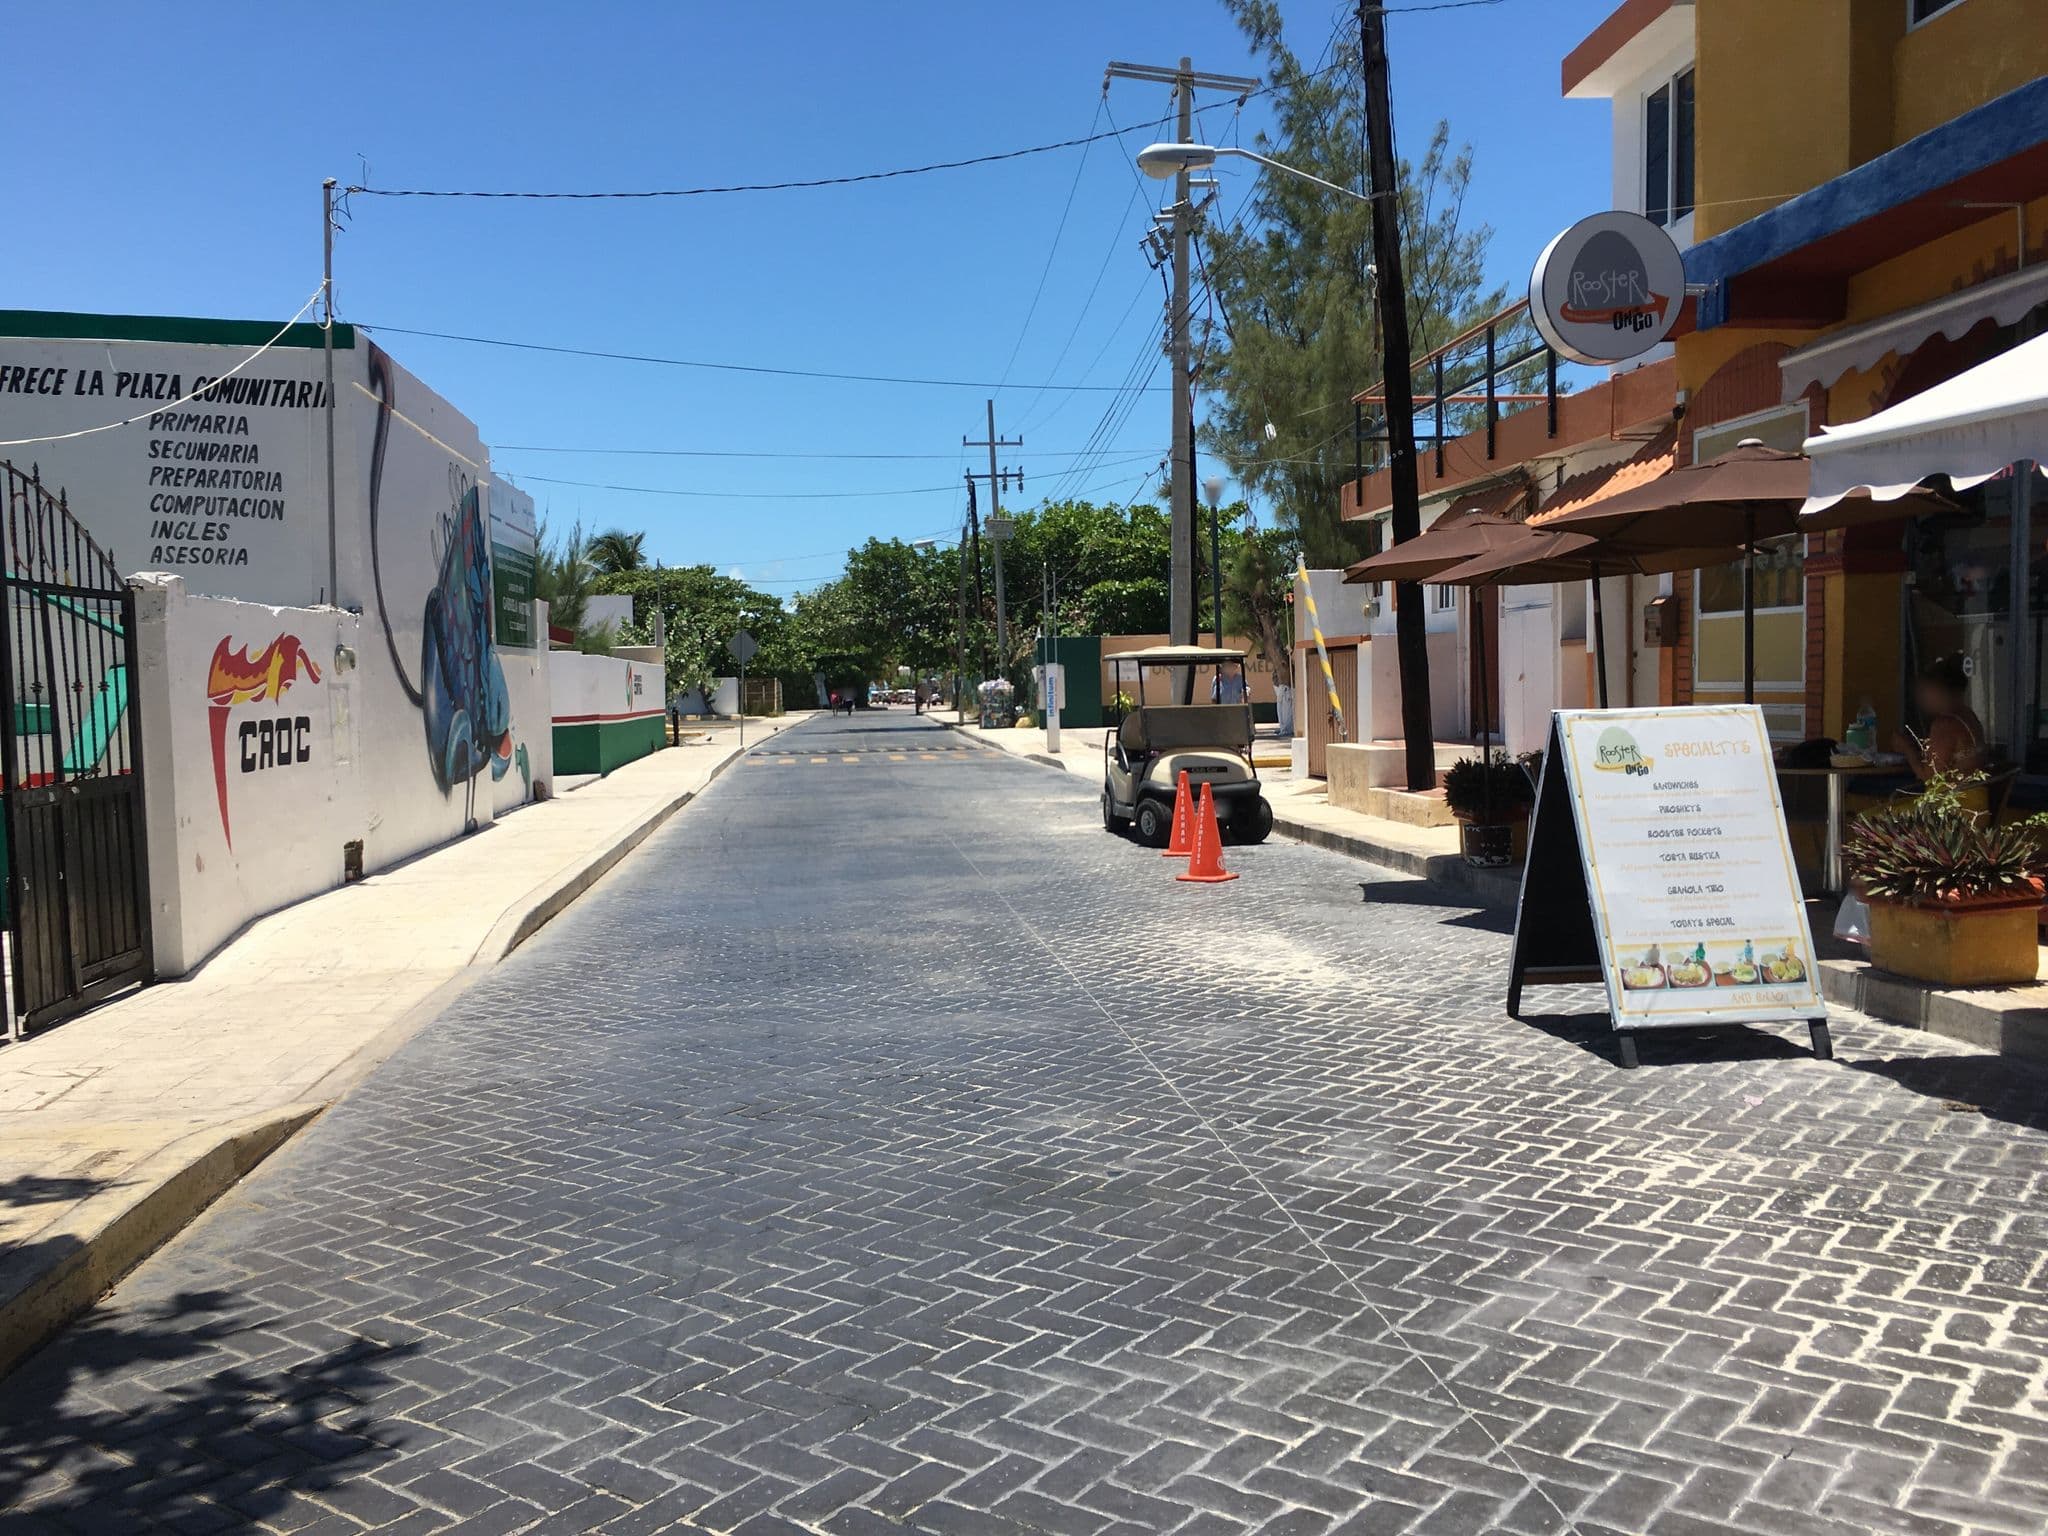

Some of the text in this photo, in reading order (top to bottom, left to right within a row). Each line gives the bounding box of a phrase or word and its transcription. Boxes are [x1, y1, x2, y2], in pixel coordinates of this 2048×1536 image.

[74, 370, 104, 396] LA
[115, 372, 181, 400] PLAZA
[191, 376, 336, 408] COMUNITARIA
[148, 412, 249, 436] PRIMARIA
[148, 439, 259, 464] SECUNDARIA
[149, 466, 283, 492] PREPARATORIA
[150, 493, 285, 521] COMPUTACION
[150, 520, 230, 541] INGLES
[150, 545, 248, 566] ASESORIA
[1653, 781, 1699, 791] SANDWICHES
[1647, 827, 1722, 839] ROOSTER POCKETS
[1660, 853, 1687, 862] TORTA
[1667, 884, 1724, 895] GRANOLA TRIO
[1706, 916, 1736, 927] SPECIAL
